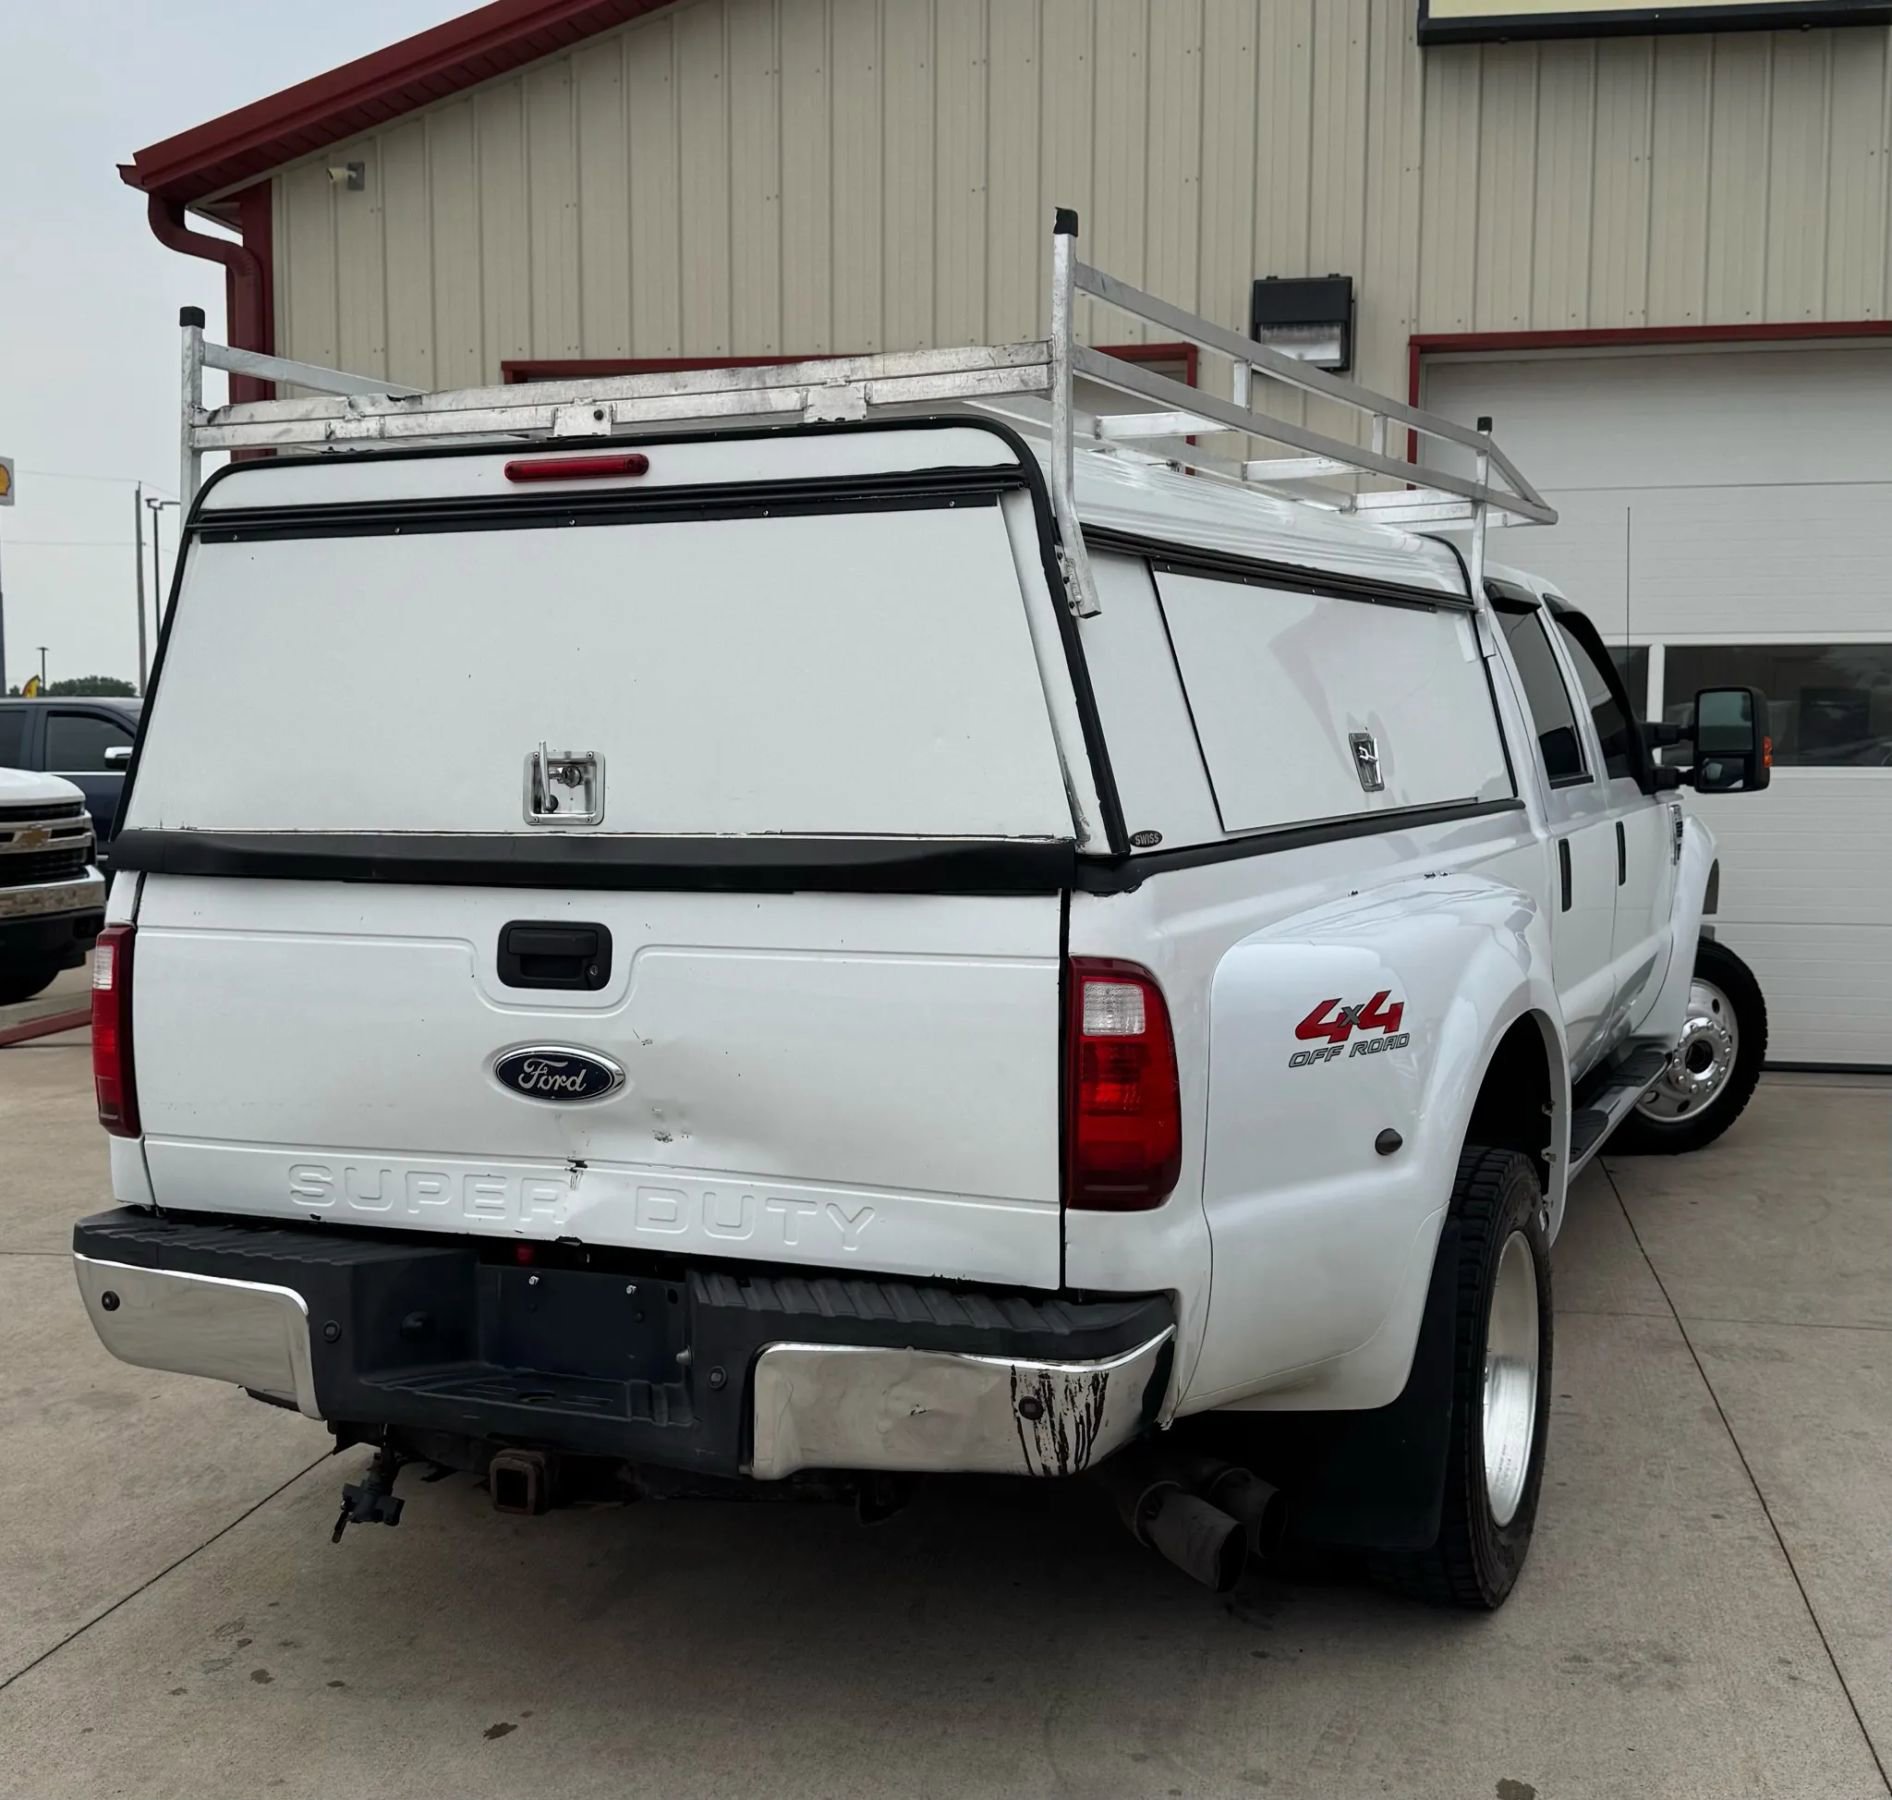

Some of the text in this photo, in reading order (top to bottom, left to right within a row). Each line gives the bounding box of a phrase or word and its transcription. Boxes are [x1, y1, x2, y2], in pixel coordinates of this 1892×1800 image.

[1135, 832, 1160, 845] SWISS
[1288, 1033, 1410, 1068] OFF ROAD
[517, 1057, 587, 1092] Ford
[288, 1164, 876, 1251] SUPER DUTY
